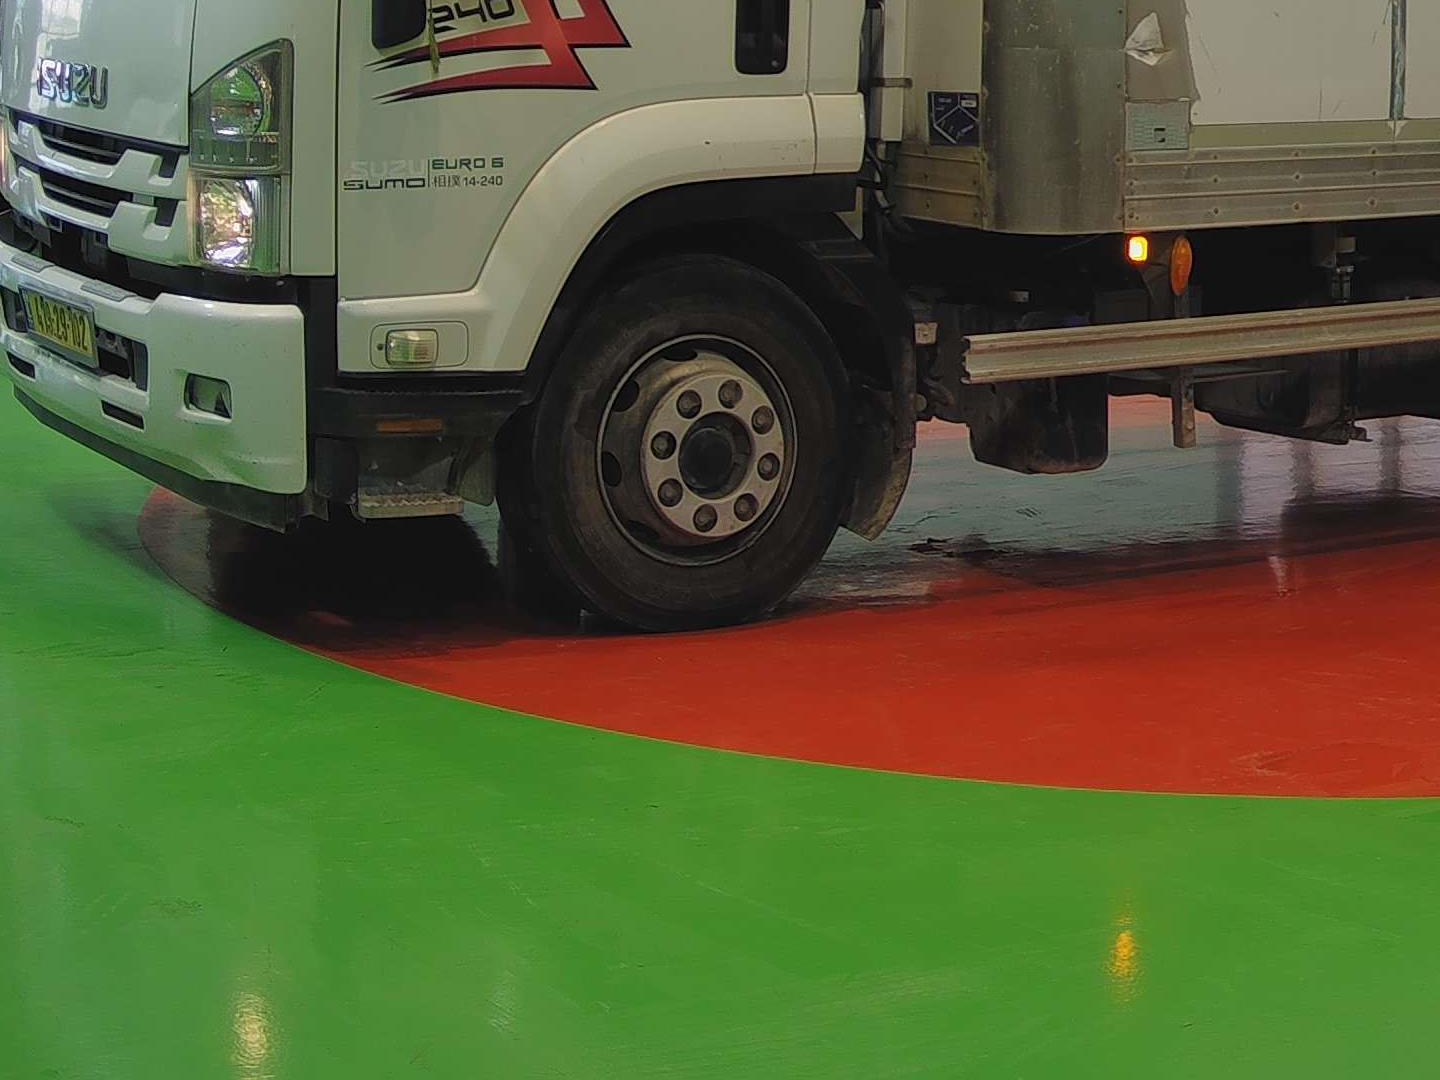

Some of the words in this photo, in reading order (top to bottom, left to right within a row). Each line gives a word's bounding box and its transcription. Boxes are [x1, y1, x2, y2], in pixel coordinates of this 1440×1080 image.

[37, 58, 109, 109] ISUZU
[432, 158, 485, 170] EURO
[491, 157, 504, 168] 6
[343, 177, 426, 190] SUMO
